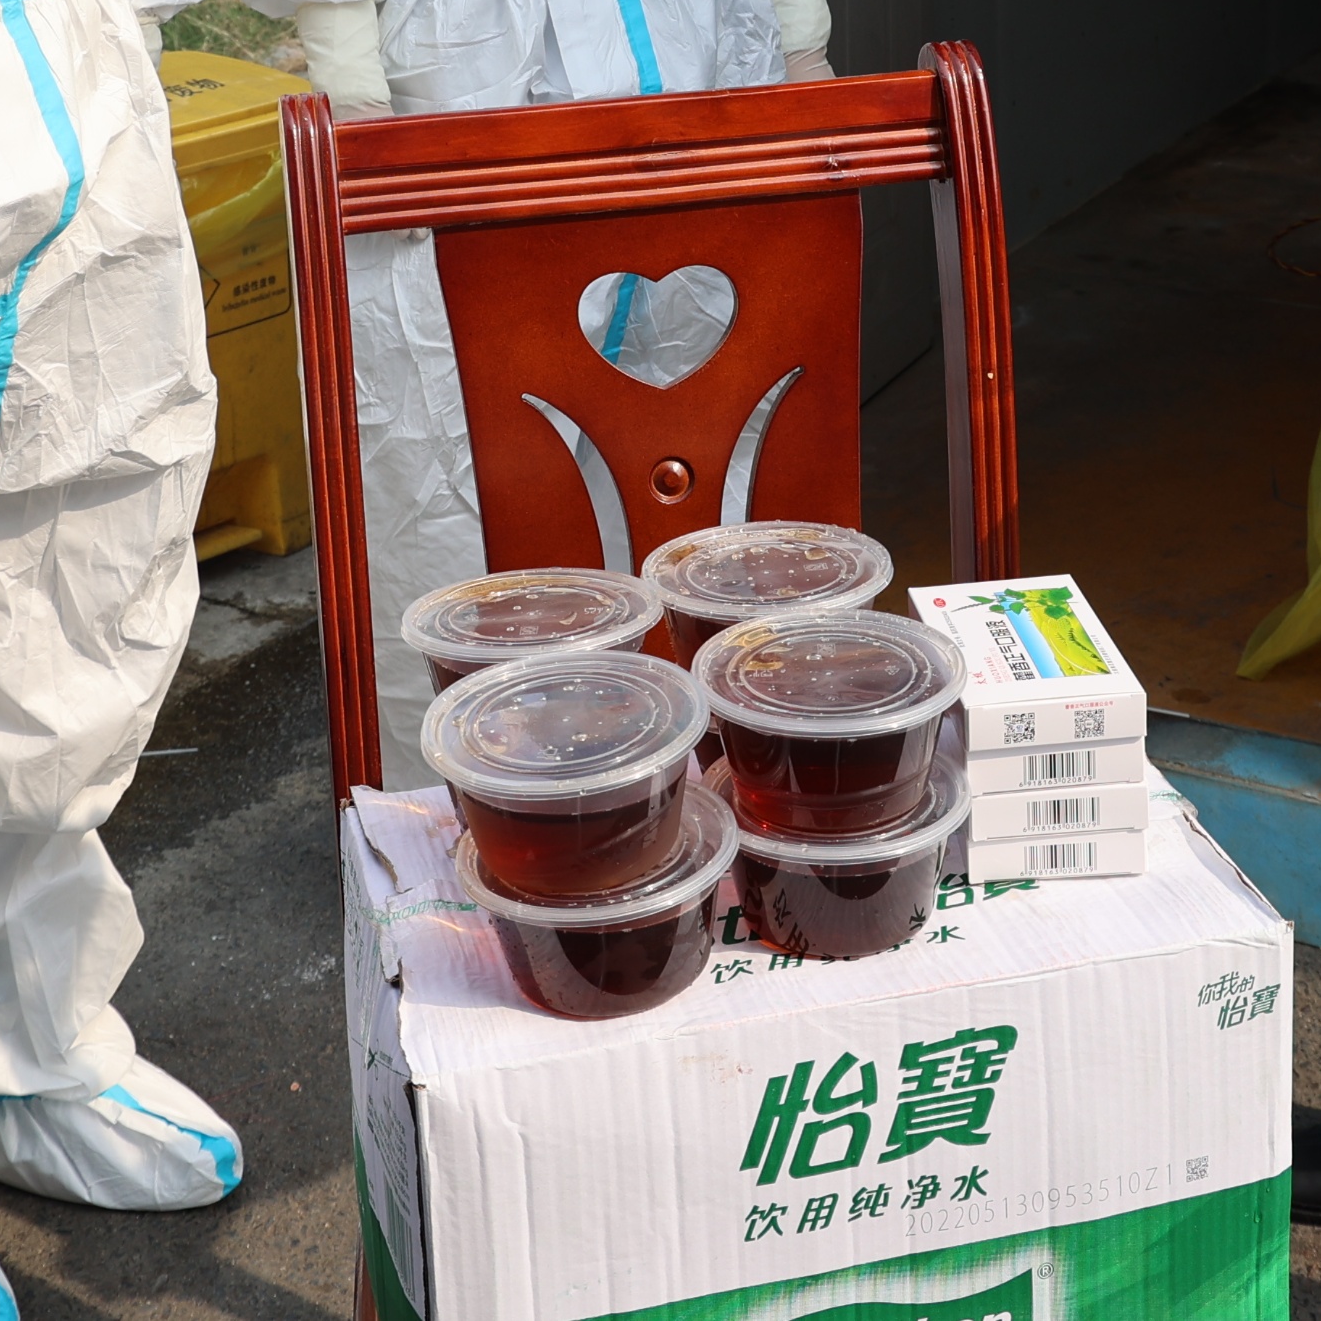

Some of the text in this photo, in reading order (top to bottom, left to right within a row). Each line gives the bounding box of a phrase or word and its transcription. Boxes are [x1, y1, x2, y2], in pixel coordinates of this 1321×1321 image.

[1197, 971, 1255, 1007] 你我的
[1216, 983, 1282, 1030] 怡寶
[739, 1025, 1019, 1187] 怡寶
[744, 1165, 990, 1243] 饮用纯净水
